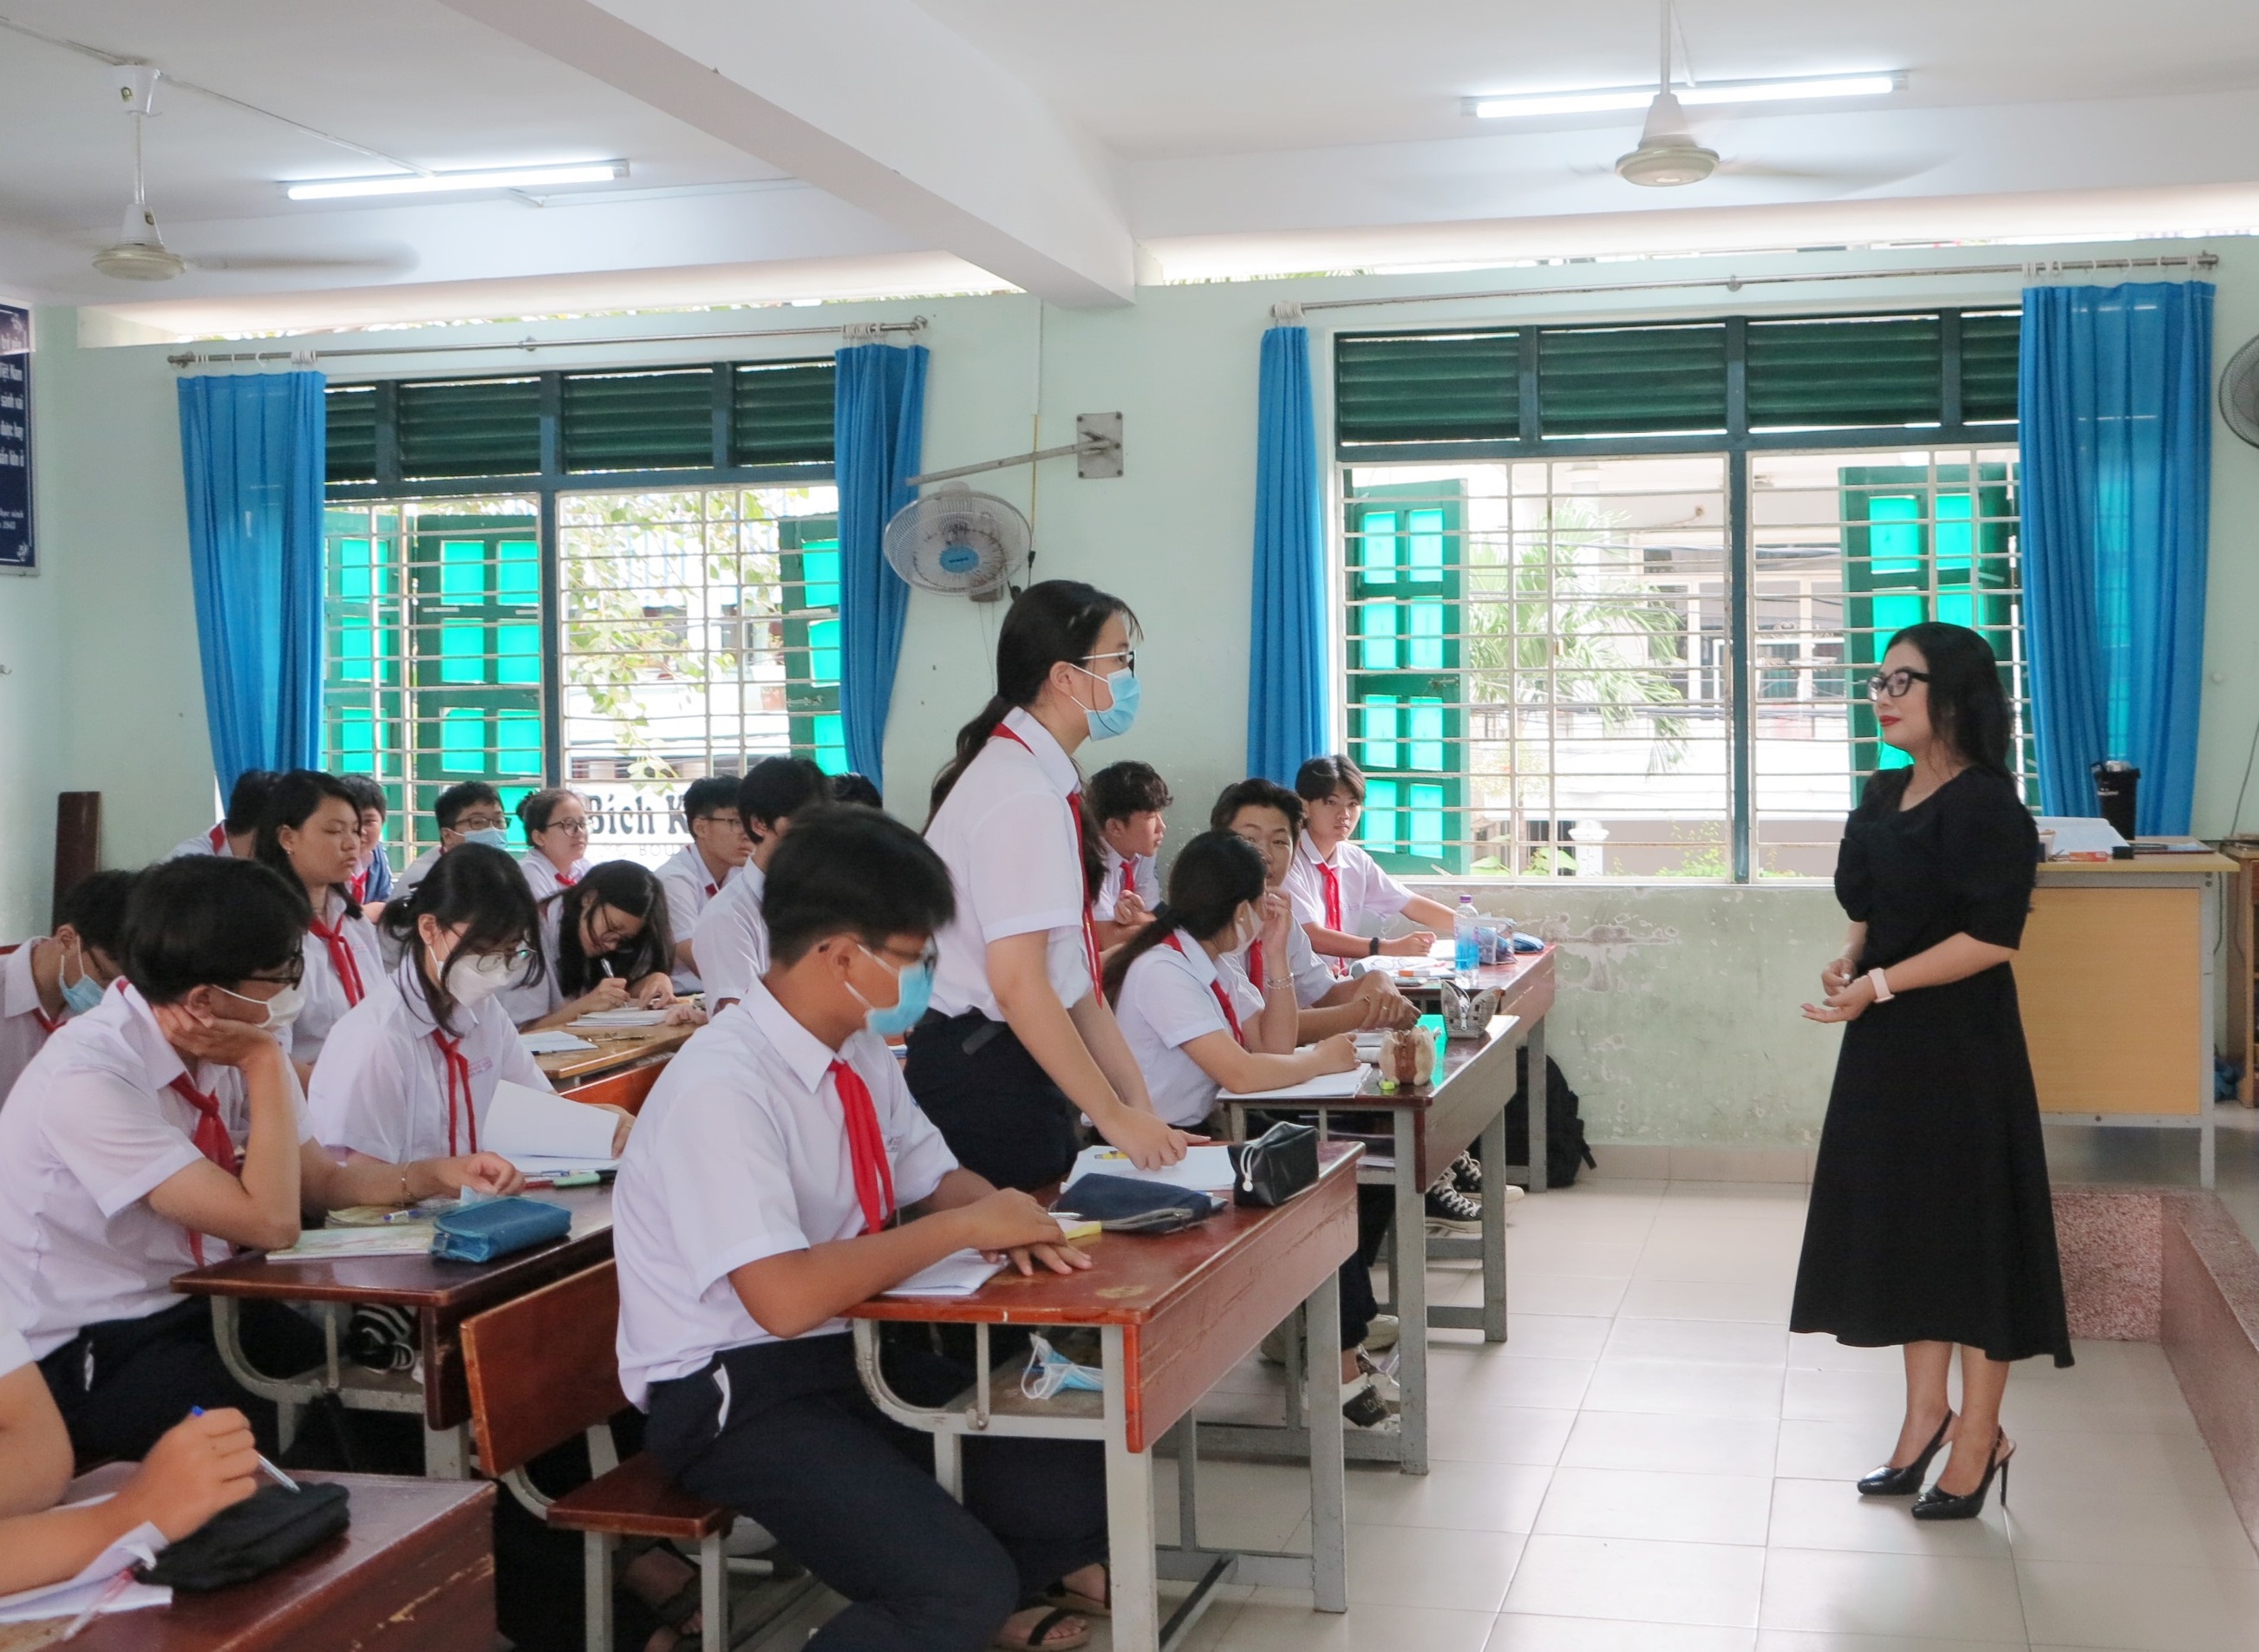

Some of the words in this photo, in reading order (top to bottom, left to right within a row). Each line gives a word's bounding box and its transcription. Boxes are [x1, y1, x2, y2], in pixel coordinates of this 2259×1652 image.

[589, 793, 656, 834] Bích
[665, 794, 690, 834] K
[639, 842, 675, 857] BOU
